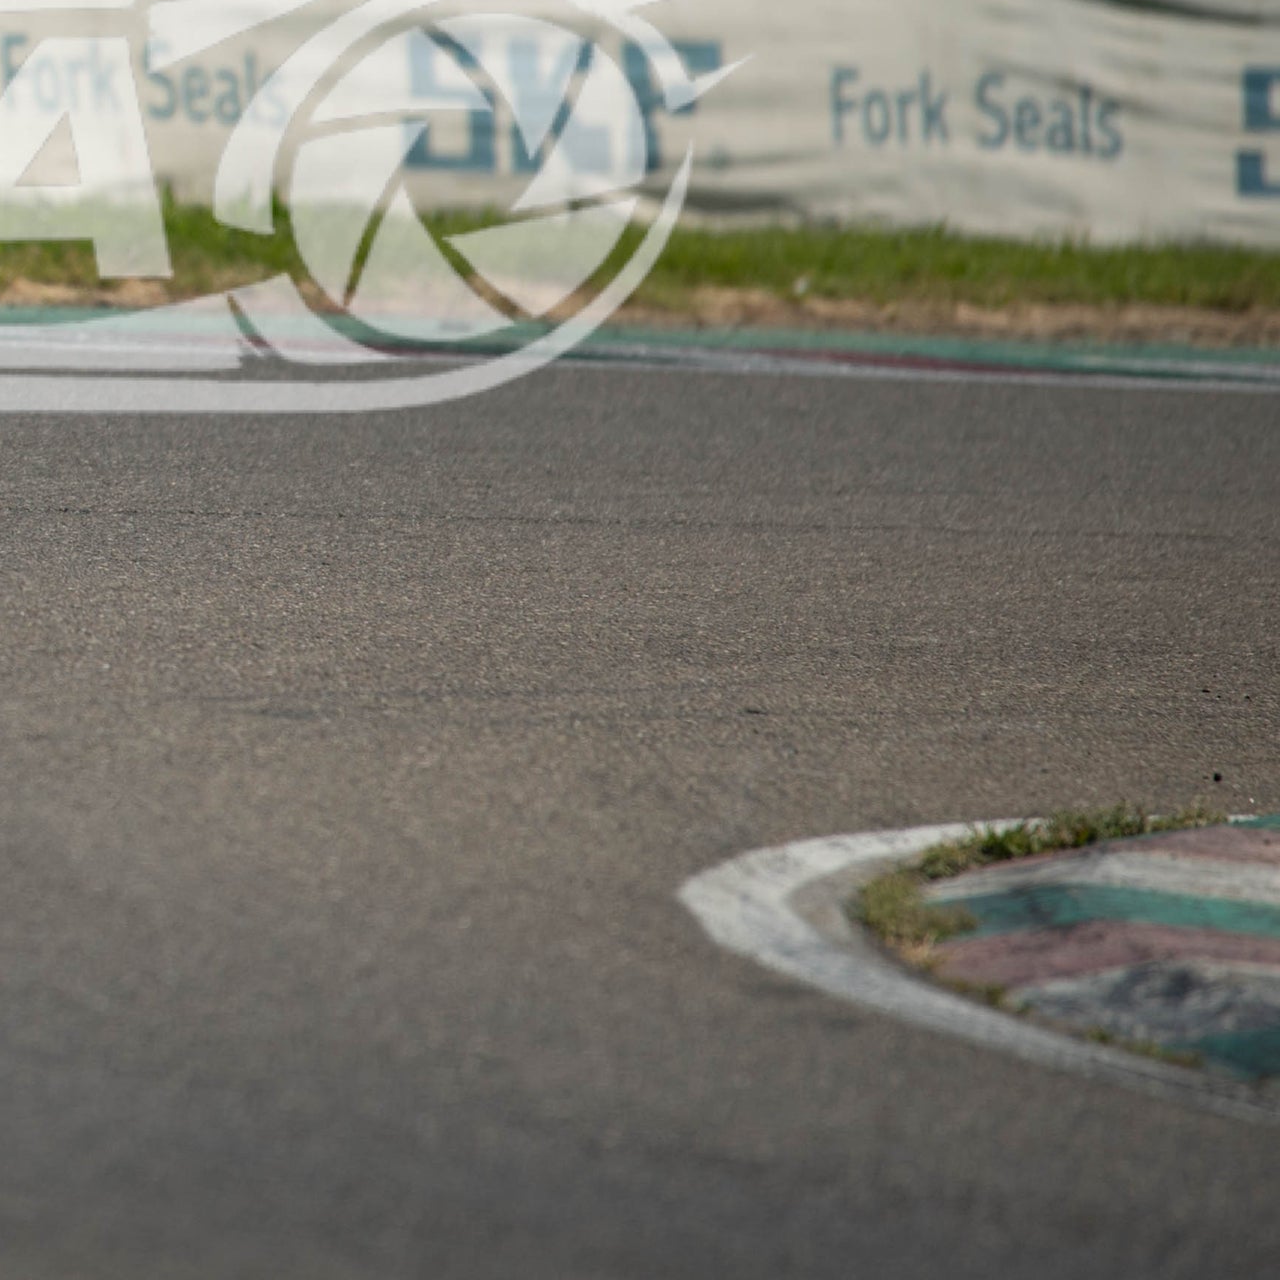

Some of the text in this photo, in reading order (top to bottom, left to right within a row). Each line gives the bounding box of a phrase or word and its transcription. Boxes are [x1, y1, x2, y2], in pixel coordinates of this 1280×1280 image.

[0, 32, 123, 116] Fork
[142, 38, 292, 129] Seals
[829, 65, 951, 147] Fork
[973, 71, 1125, 161] Seals
